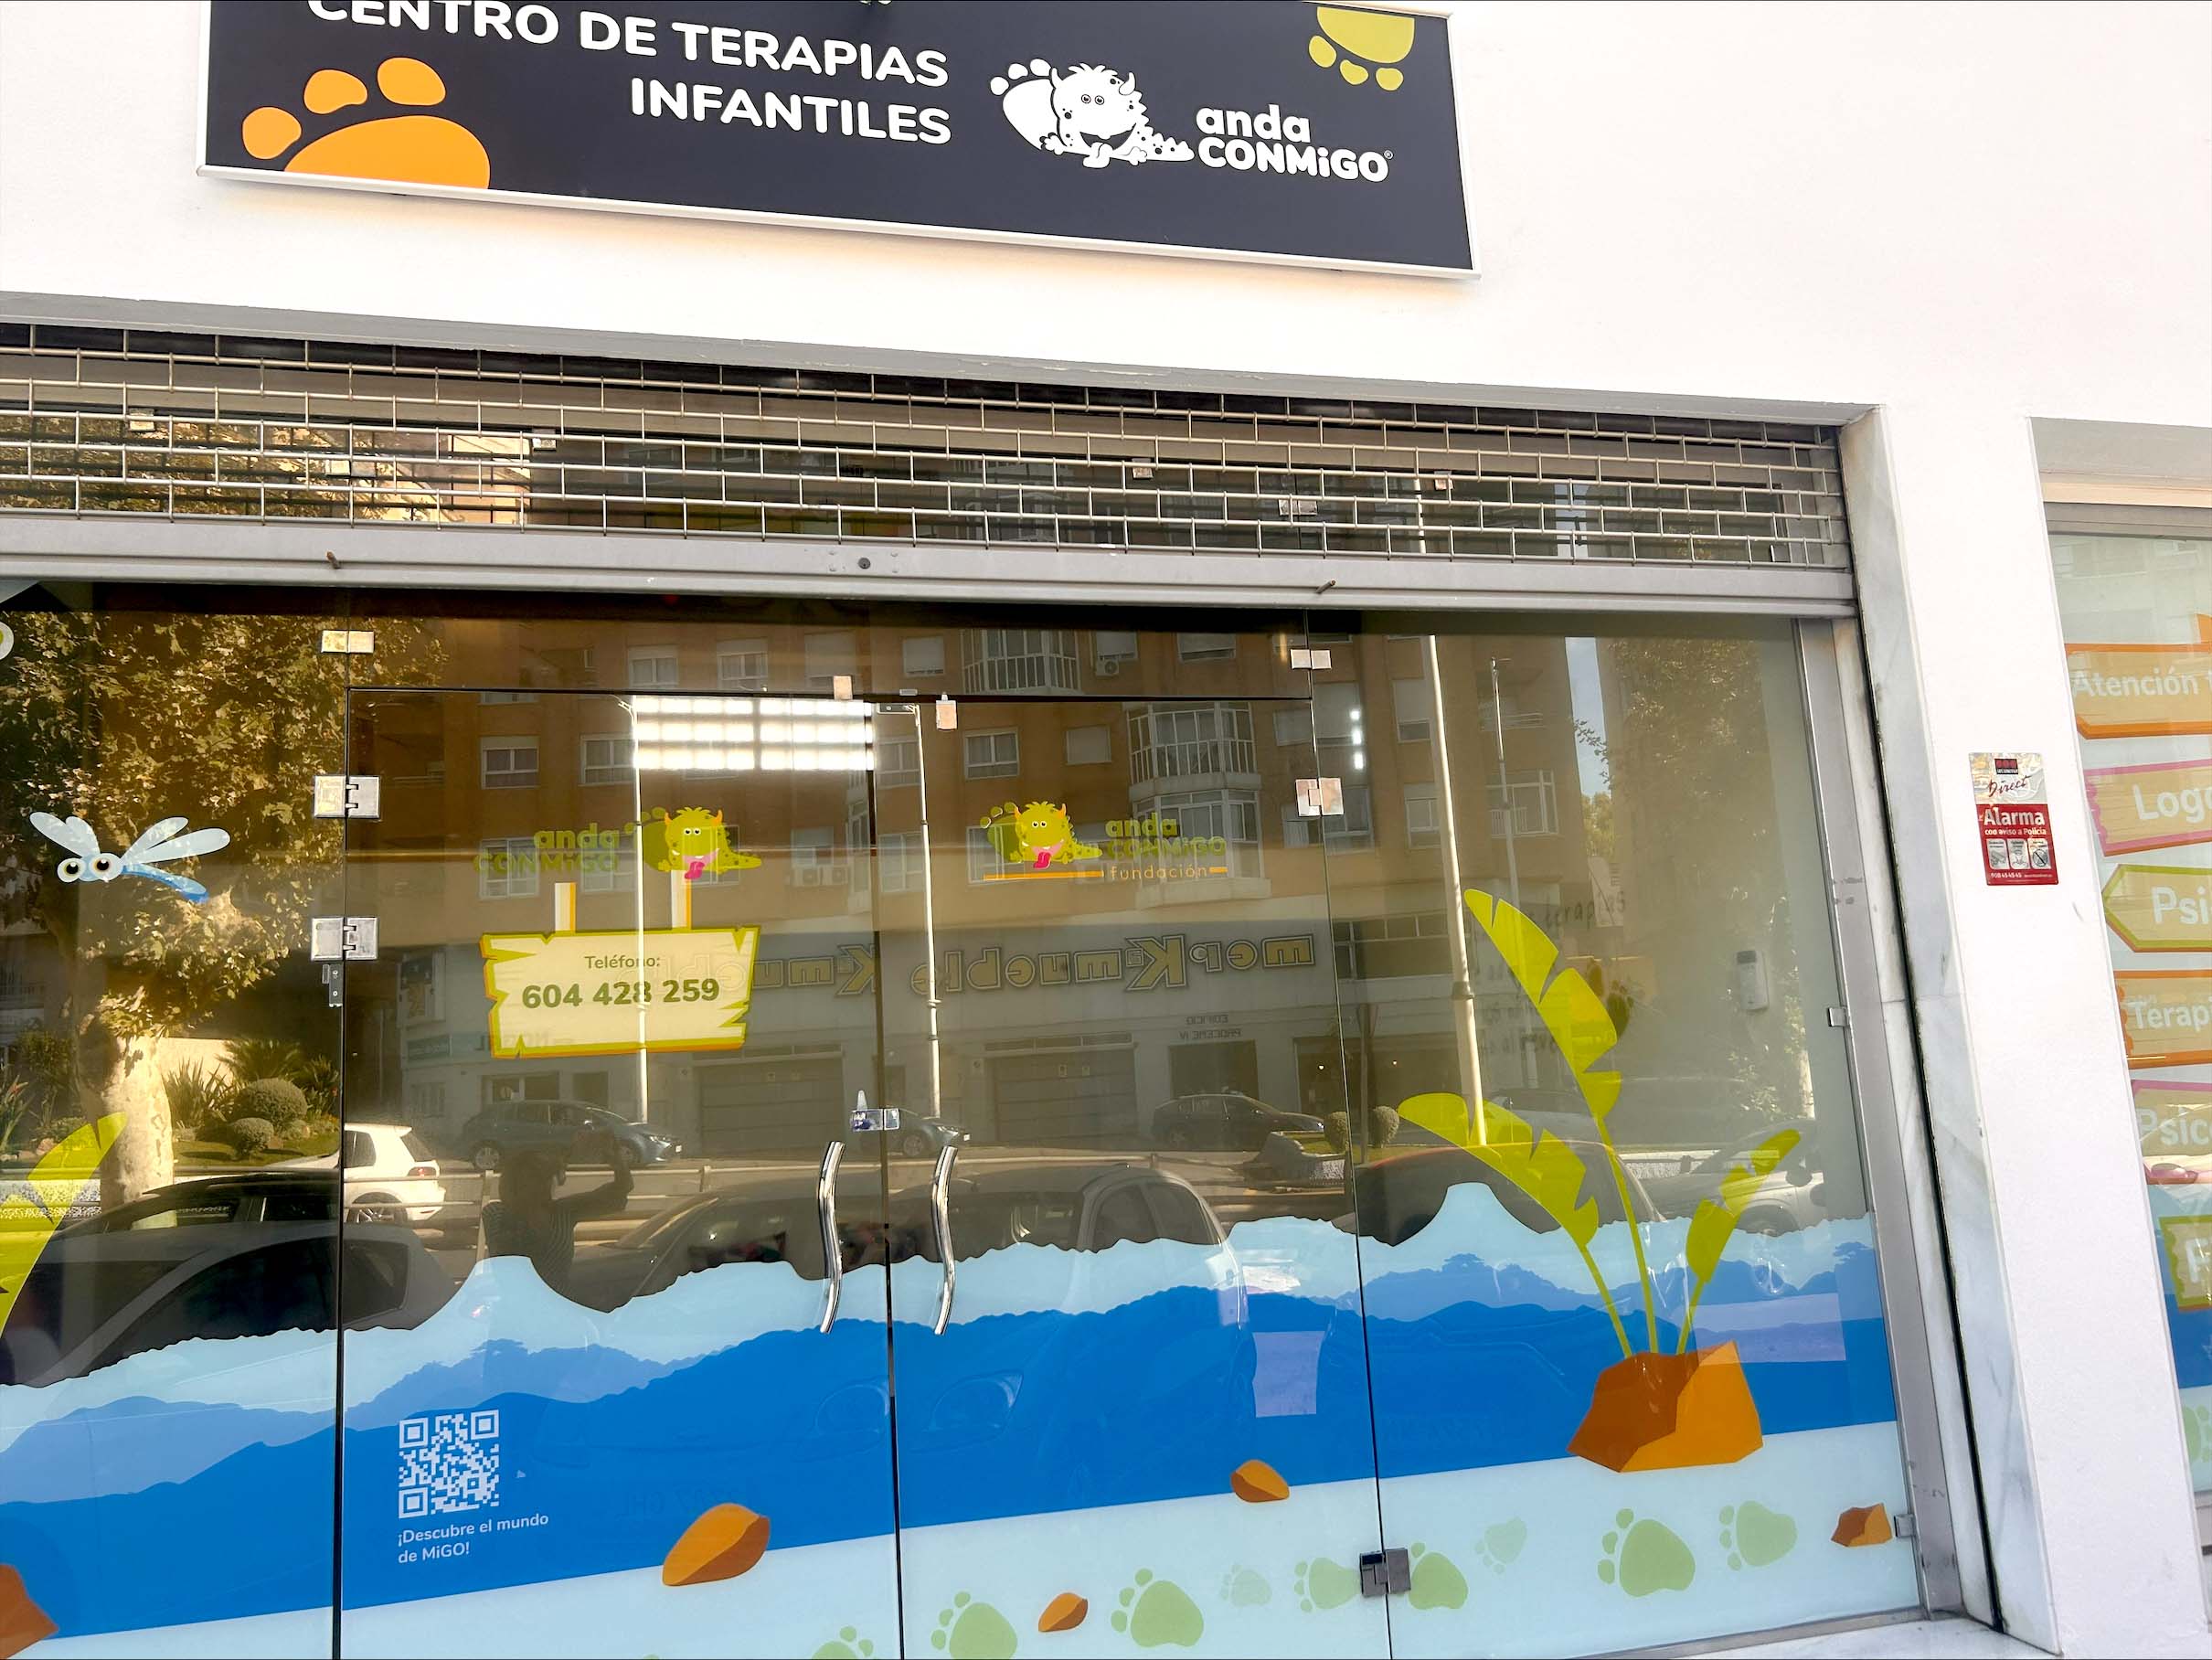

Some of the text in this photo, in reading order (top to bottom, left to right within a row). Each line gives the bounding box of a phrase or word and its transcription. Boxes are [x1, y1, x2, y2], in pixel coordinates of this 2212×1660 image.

[307, 0, 950, 88] CENTRO DE TERAPIAS
[631, 77, 952, 145] INFANTILES
[1196, 103, 1311, 144] anda
[2072, 665, 2199, 698] Atención
[1987, 775, 2033, 797] Direct
[1105, 812, 1178, 837] anda
[1984, 807, 2046, 825] Alarma
[534, 823, 620, 849] anda
[1998, 827, 2016, 835] aviso
[1107, 836, 1228, 859] CONMiGO
[473, 851, 620, 876] CONMiGO
[1111, 864, 1207, 880] fundación
[584, 954, 660, 969] Teléfono:
[522, 978, 719, 1009] 604 428 259
[2136, 1106, 2212, 1145] Psic
[398, 1513, 549, 1548] ¡Descubre el mundo
[398, 1541, 471, 1564] de MiGO!
